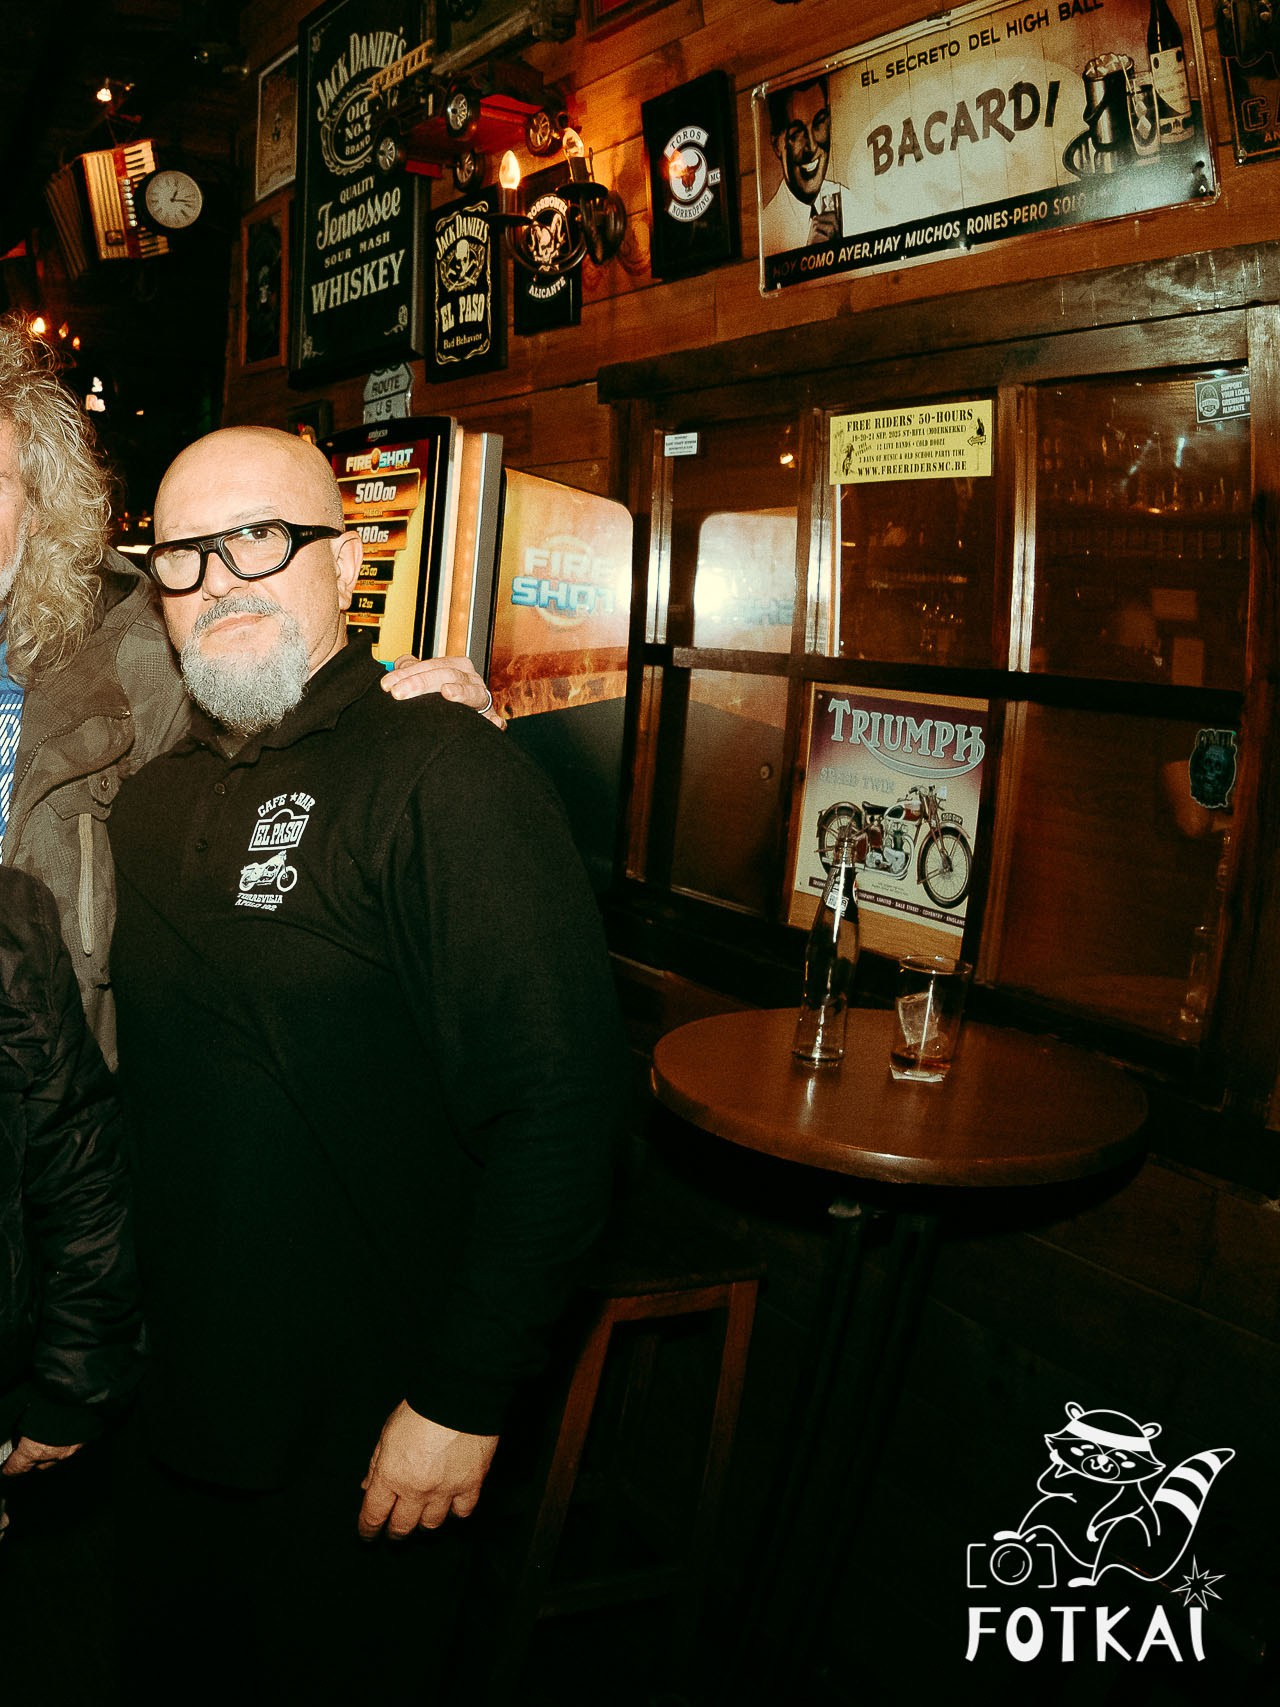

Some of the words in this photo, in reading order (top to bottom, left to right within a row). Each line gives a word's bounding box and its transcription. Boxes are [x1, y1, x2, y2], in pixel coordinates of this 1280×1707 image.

[861, 72, 879, 87] EL
[886, 40, 961, 79] SECRETO
[969, 28, 1000, 50] DEL
[1006, 9, 1050, 38] HIGH
[1059, 0, 1103, 21] BALL
[316, 51, 349, 122] JACK
[346, 99, 369, 123] Old
[670, 129, 703, 150] TOROS
[867, 80, 1061, 176] BACARDI
[345, 134, 371, 156] BRAND
[339, 175, 376, 204] QUALITY
[316, 186, 401, 250] Tennessee
[324, 248, 352, 268] SOUR
[359, 230, 391, 254] MASH
[435, 223, 457, 260] JACK
[773, 258, 797, 278] HOY
[800, 250, 834, 271] COMO
[905, 220, 960, 249] MUCHOS
[310, 249, 405, 315] WHISKEY
[528, 275, 566, 299] ALICANTE
[440, 302, 455, 333] EL
[458, 293, 485, 324] PASO
[443, 337, 455, 350] Bad
[372, 374, 403, 394] ROUTE
[847, 419, 871, 432] FREE
[875, 414, 915, 429] RIDERS'
[918, 408, 973, 425] 50-HOURS
[346, 454, 372, 472] FIRE
[379, 448, 414, 468] SHOT
[914, 450, 933, 458] SCHOOL
[935, 449, 951, 458] PARTY
[857, 461, 967, 476] WWW.FREERIDERSMC.BE
[523, 547, 616, 581] FIRE
[511, 576, 617, 616] SHOT
[828, 698, 986, 778] TRIUMPH
[295, 792, 316, 812] BAR
[253, 824, 271, 846] EL
[269, 820, 304, 845] PASO
